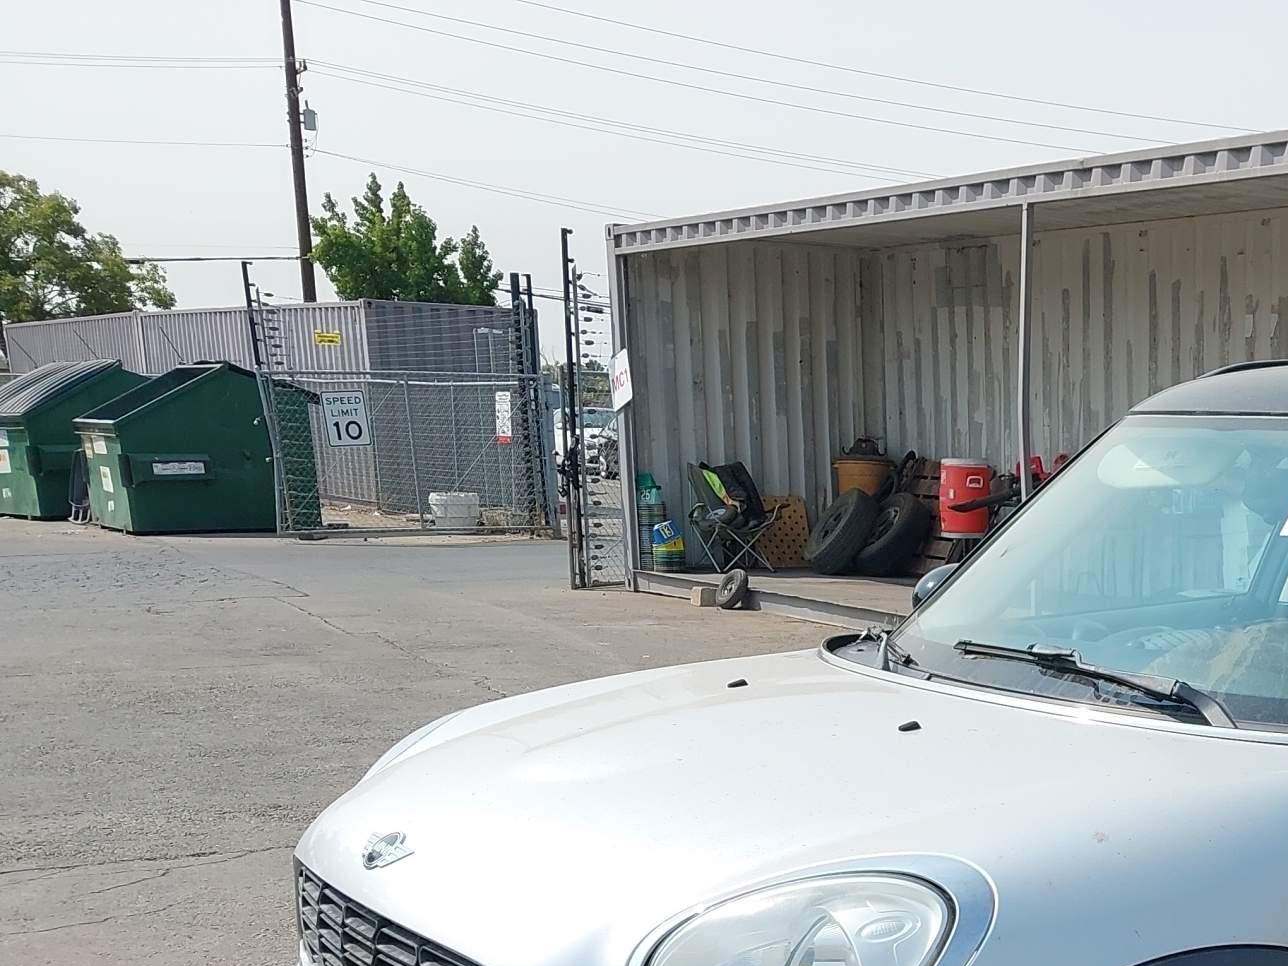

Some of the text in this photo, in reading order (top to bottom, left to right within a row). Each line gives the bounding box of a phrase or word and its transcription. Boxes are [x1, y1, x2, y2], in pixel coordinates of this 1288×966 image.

[325, 396, 361, 405] SPEED
[331, 408, 358, 417] LIMIT
[333, 420, 362, 440] 10
